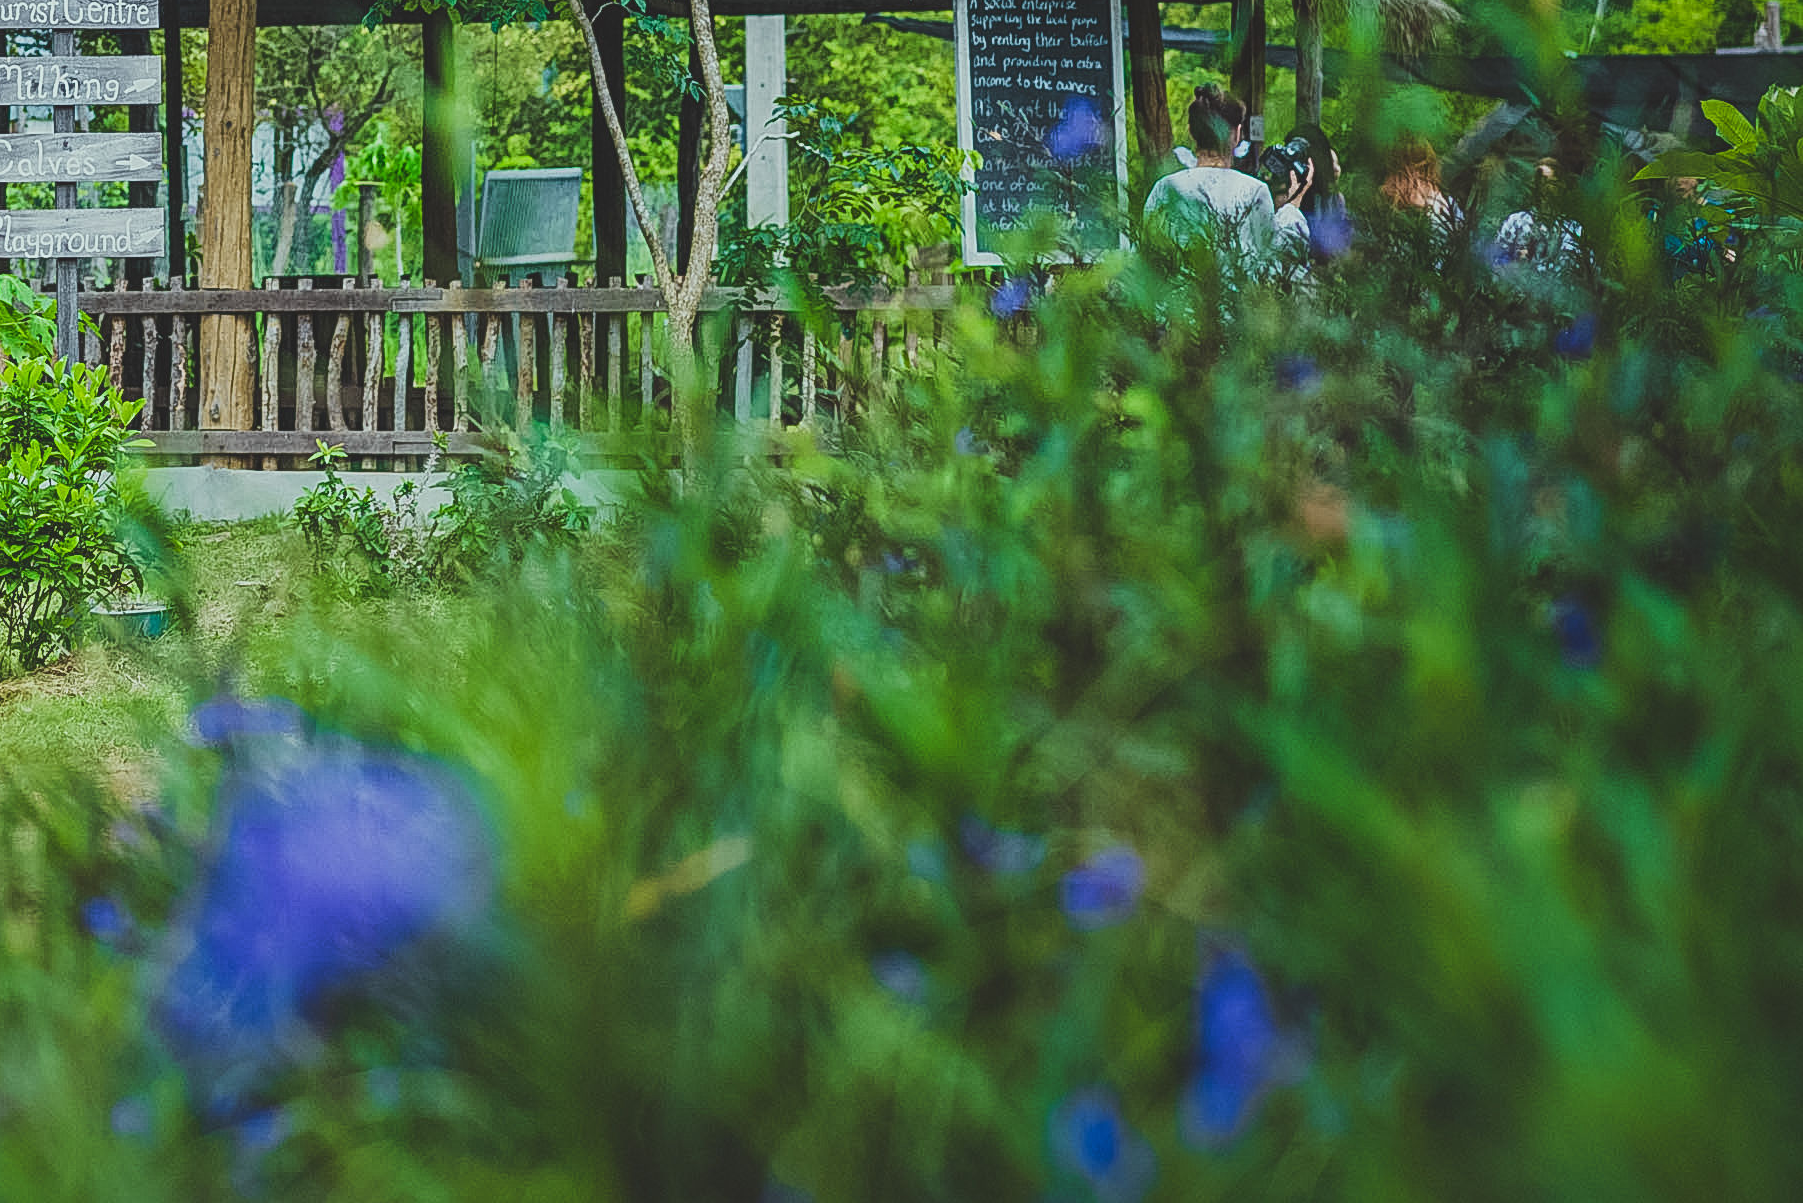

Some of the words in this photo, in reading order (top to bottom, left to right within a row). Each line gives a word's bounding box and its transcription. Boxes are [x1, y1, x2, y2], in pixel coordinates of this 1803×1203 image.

[971, 12, 1023, 30] supporting
[1027, 13, 1042, 25] the
[1046, 13, 1068, 26] local
[972, 31, 987, 51] by
[991, 33, 1031, 52] renting
[1035, 32, 1064, 48] their
[973, 52, 996, 68] and
[1002, 54, 1057, 76] providing
[1061, 57, 1074, 69] an
[1076, 55, 1103, 69] extra
[974, 71, 1012, 88] income
[1017, 72, 1032, 89] to
[1033, 75, 1053, 91] the
[1009, 174, 1027, 192] of
[1003, 198, 1021, 213] the
